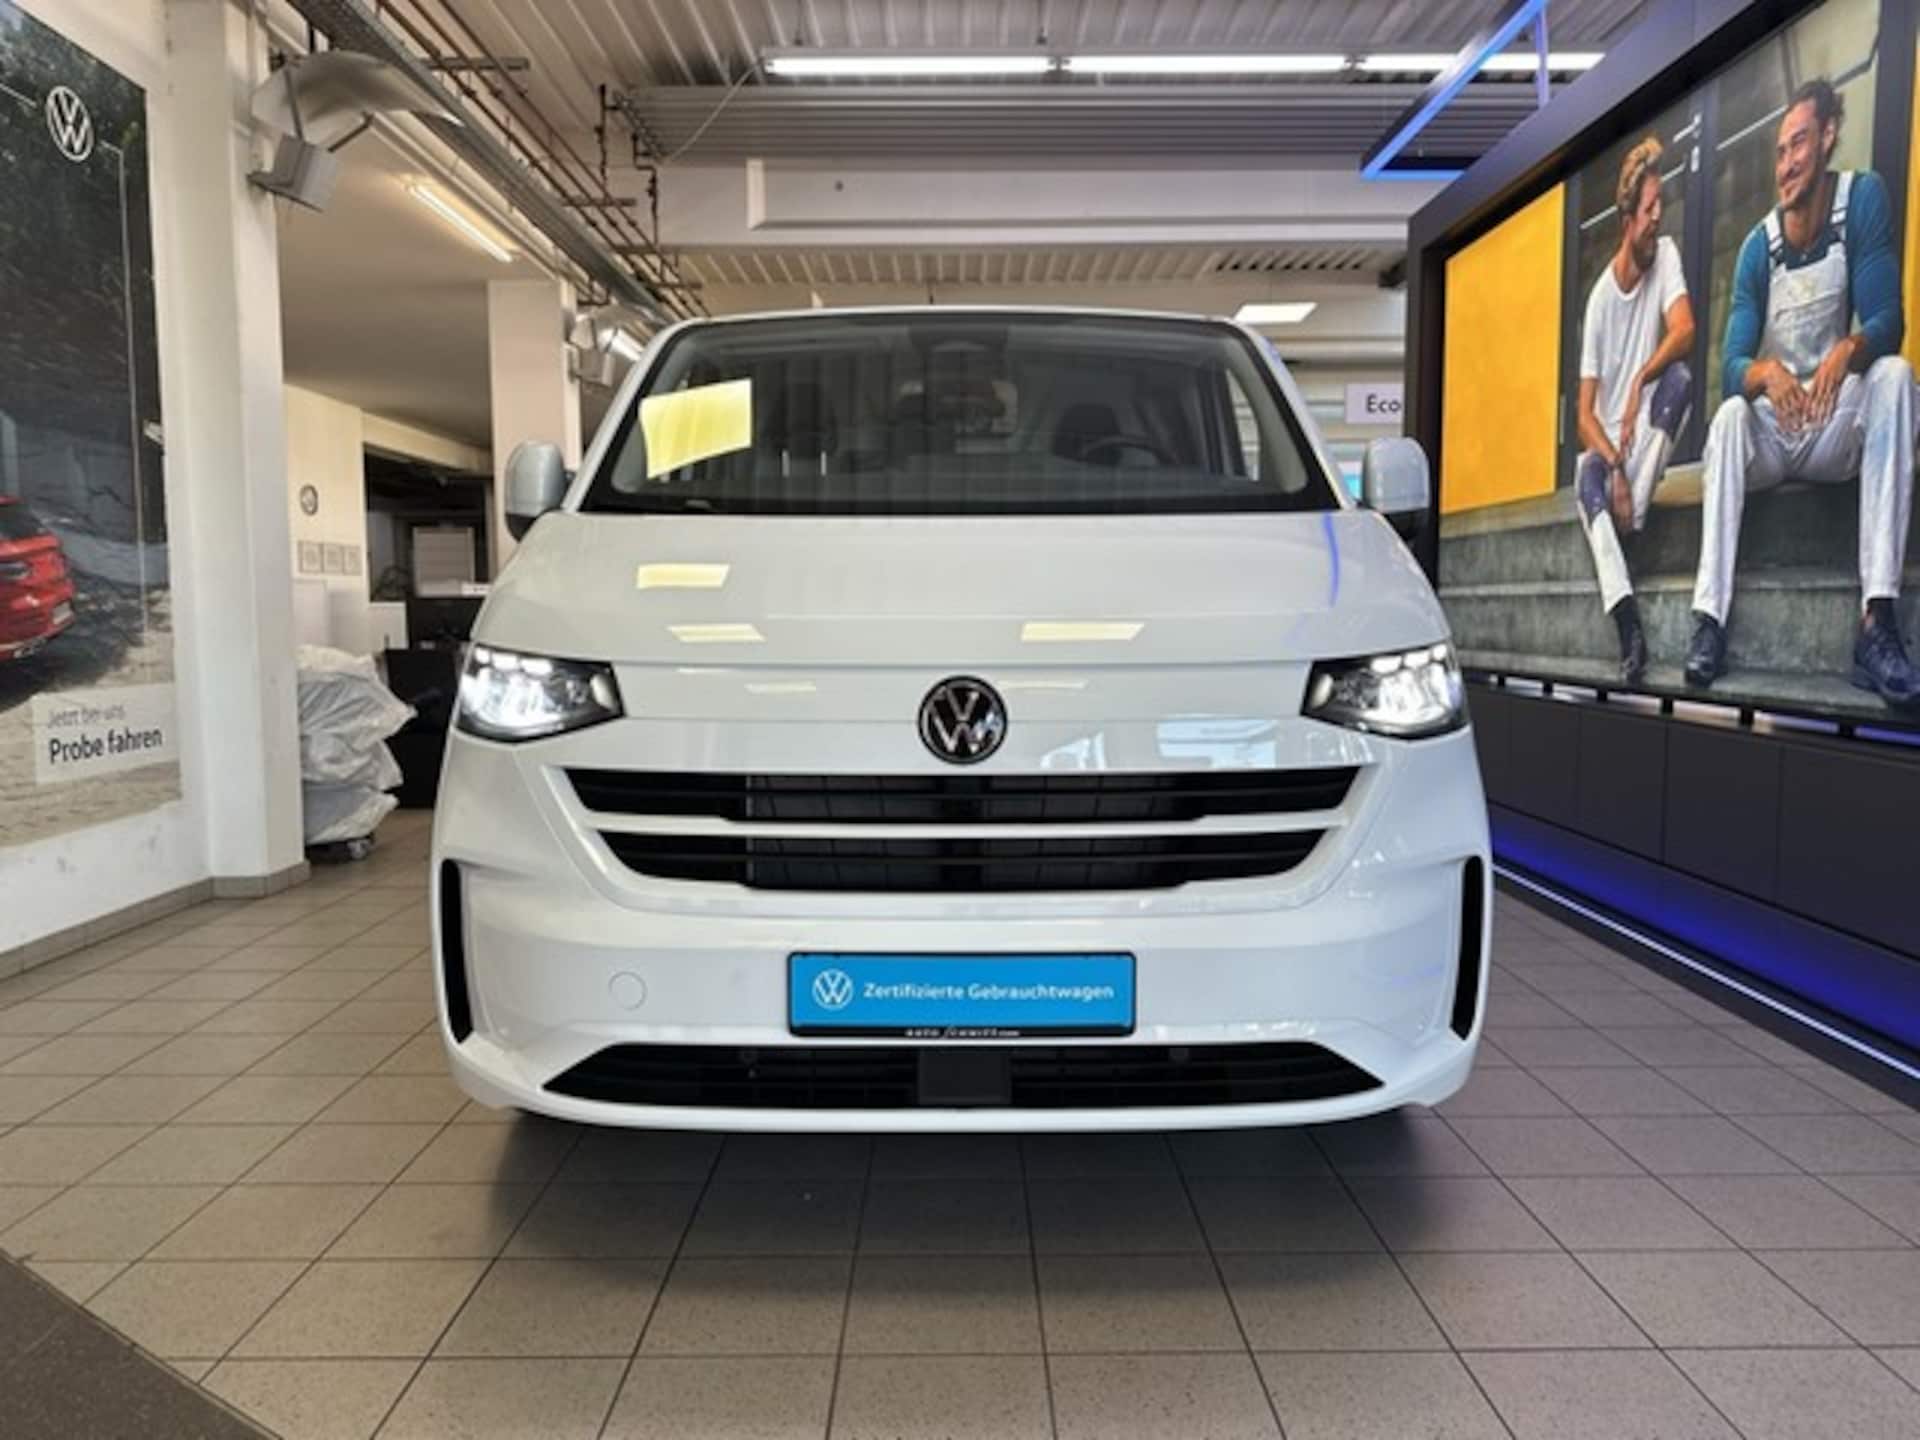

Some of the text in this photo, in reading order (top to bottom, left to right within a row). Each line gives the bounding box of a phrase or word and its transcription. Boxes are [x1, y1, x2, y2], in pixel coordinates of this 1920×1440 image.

[49, 727, 162, 764] Probe fahren
[863, 982, 1115, 1002] Zertifizierte Gebrauchtwagen
